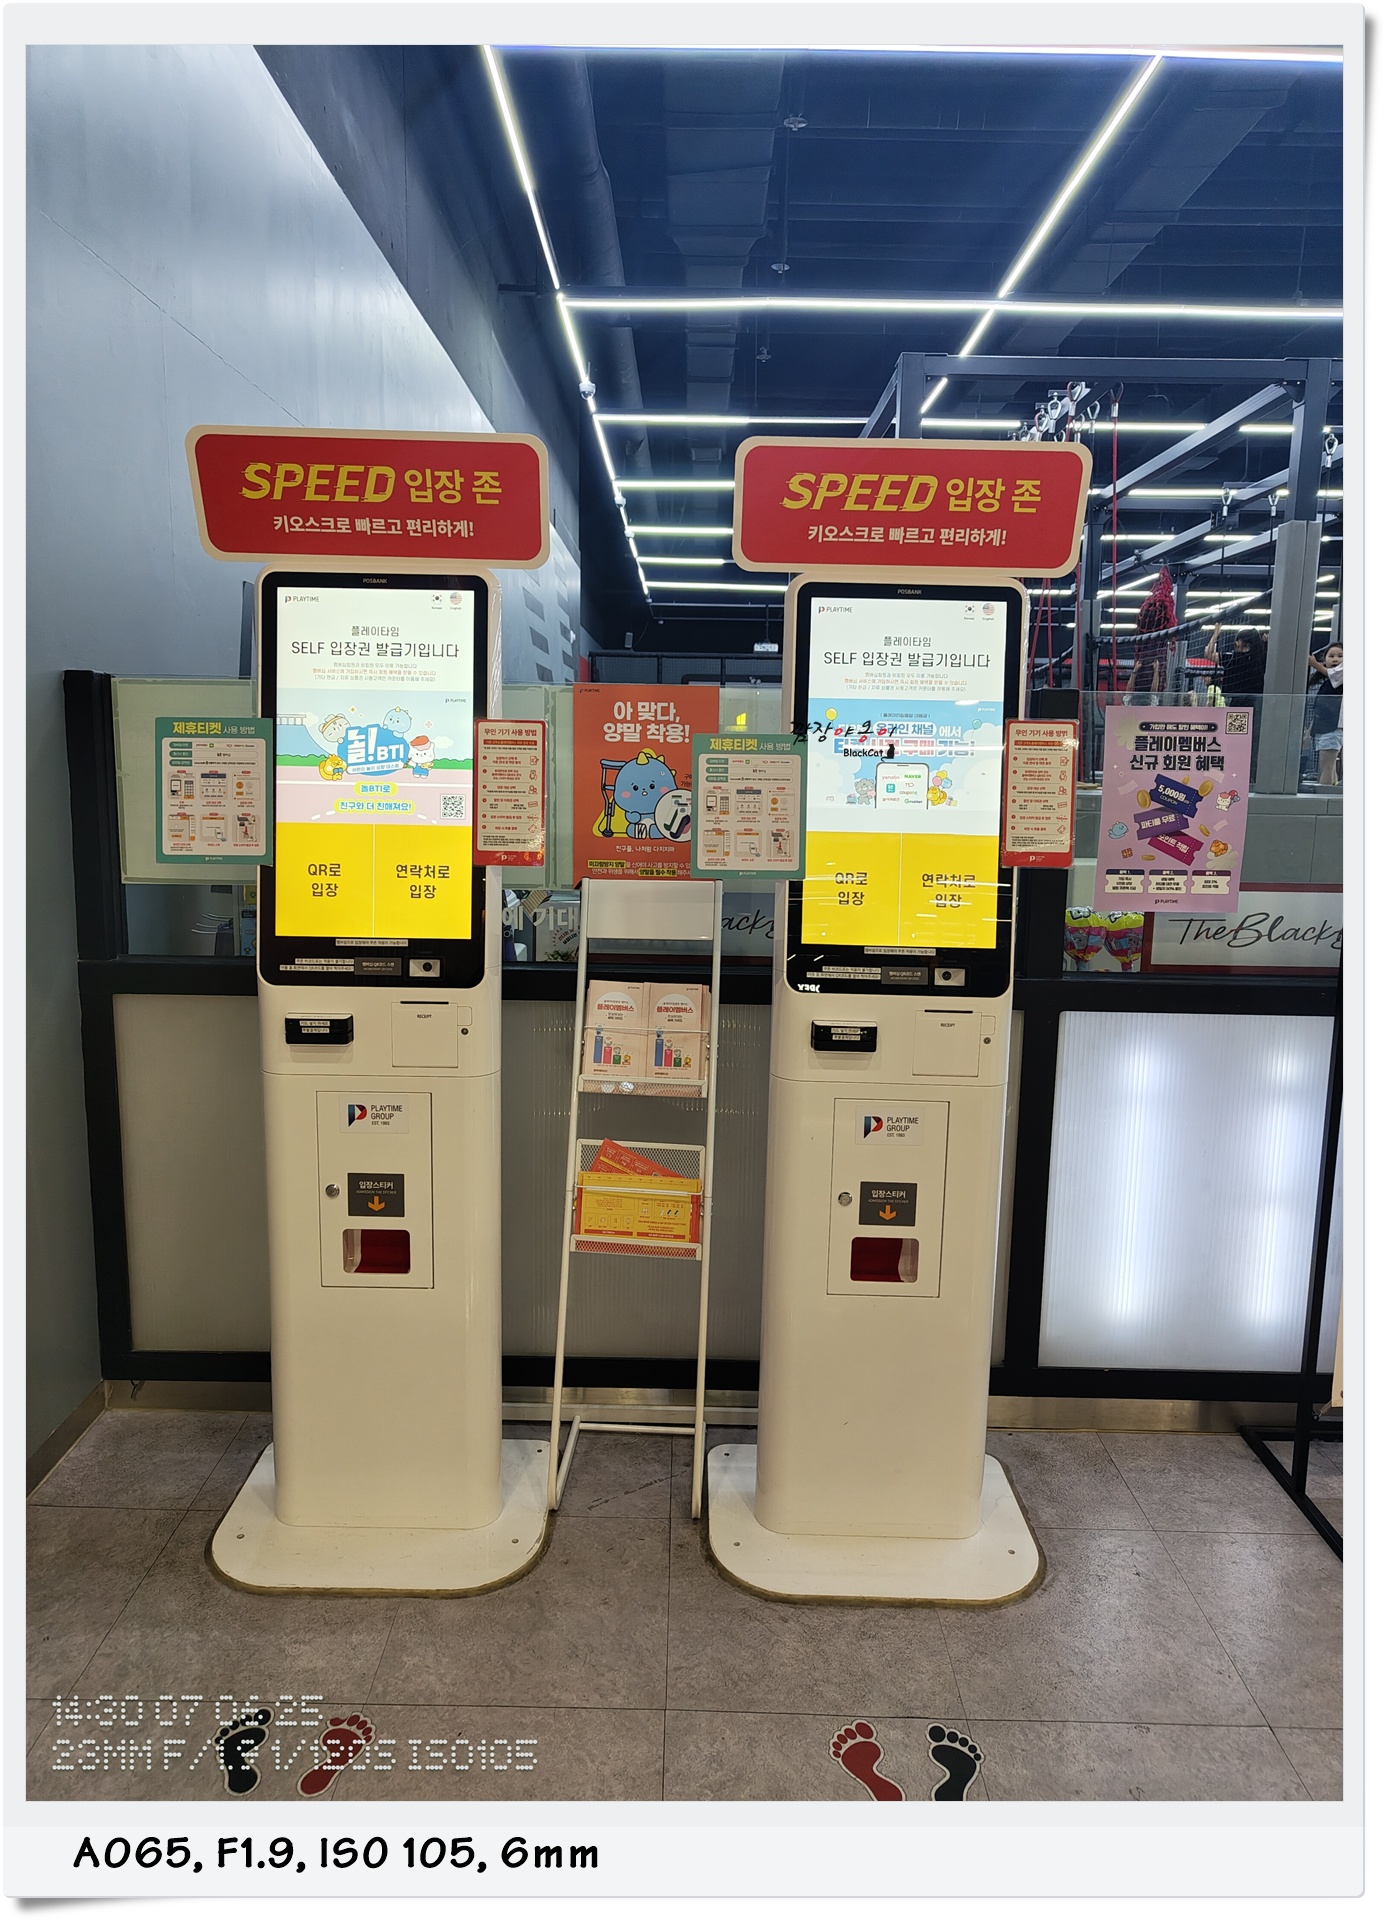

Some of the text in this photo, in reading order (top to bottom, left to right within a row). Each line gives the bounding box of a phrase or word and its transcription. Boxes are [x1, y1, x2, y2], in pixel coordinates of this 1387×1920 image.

[238, 462, 503, 505] SPEED 입장 존
[779, 472, 1042, 513] SPEED 입장 존
[273, 516, 474, 537] 키오스크로 빠르고 편리하게!
[807, 525, 1007, 546] 키오스크로 빠르고 편리하게!
[351, 625, 400, 637] 플레이타임
[883, 636, 932, 647] 플레이타임
[291, 641, 459, 658] SELF 입장권 발급기입니다
[823, 652, 990, 668] SELF 입장권 발급기입니다
[613, 701, 681, 723] 아 맞다,
[172, 721, 255, 735] 제휴티켓 사용 방법
[484, 728, 537, 737] 무인 기기 사용 방법
[603, 722, 690, 744] 양말 착용!
[911, 723, 934, 735] 채널
[939, 725, 962, 738] 에서
[1015, 729, 1028, 737] 무인
[1028, 729, 1041, 737] 기기
[709, 738, 791, 751] 제휴티켓 사용 방법
[1134, 735, 1222, 752] 플레이멤버스
[1129, 754, 1225, 771] 신규 회원 혜택
[360, 784, 391, 793] 놀BTI로
[1157, 784, 1186, 802] 5,000원
[339, 801, 412, 811] 친구와 더 친해져요!
[307, 863, 342, 877] QR로
[395, 864, 451, 879] 연락처로
[311, 883, 339, 897] 입장
[409, 884, 437, 899] 입장
[837, 891, 865, 906] 입장
[935, 893, 962, 909] 입장
[596, 1003, 635, 1012] 플레이멤버스
[656, 1006, 693, 1014] 플레이멤버스
[370, 1104, 403, 1112] PLAYTIME
[886, 1117, 919, 1125] PLAYTIME
[358, 1180, 394, 1190] 입장스티커
[871, 1189, 906, 1198] 입장스티커
